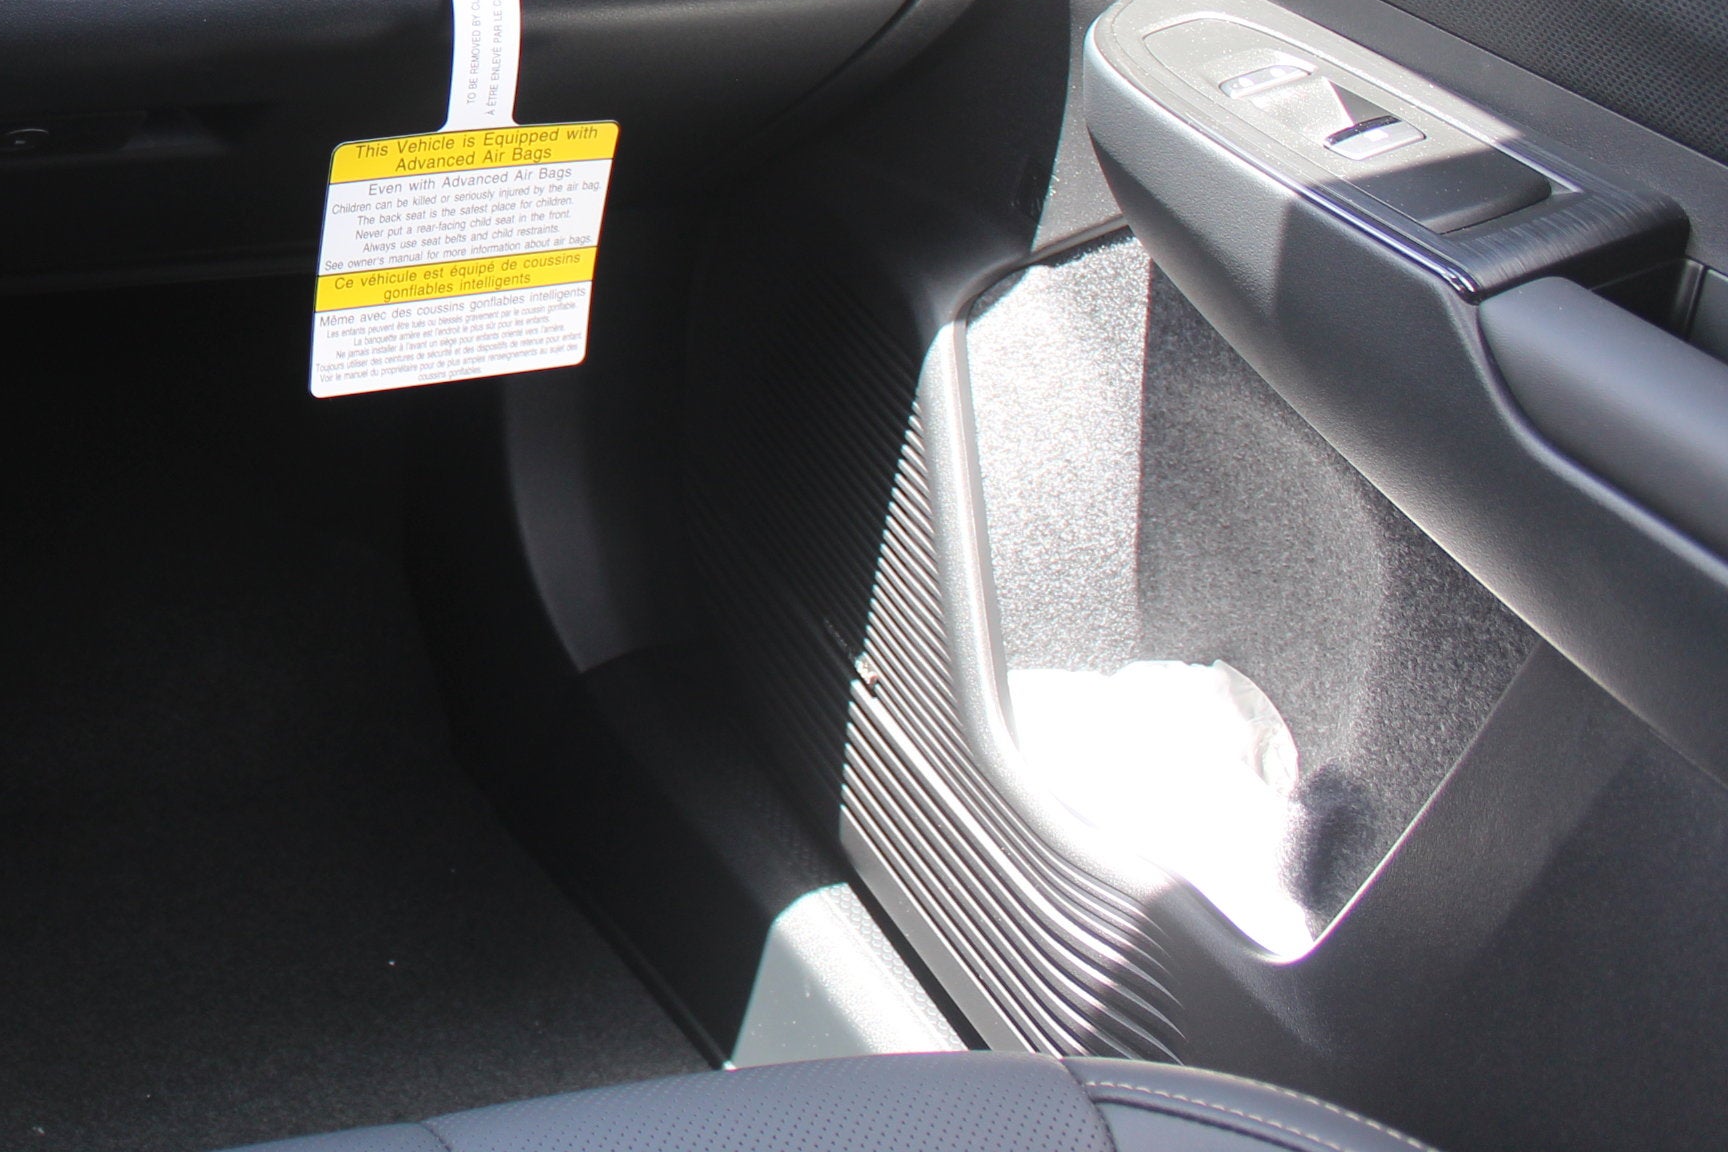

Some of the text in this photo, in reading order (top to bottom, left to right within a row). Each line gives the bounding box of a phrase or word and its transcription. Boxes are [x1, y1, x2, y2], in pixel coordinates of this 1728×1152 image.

[468, 77, 478, 90] BE
[466, 92, 477, 105] TO
[356, 126, 598, 159] This Vehicle is Equipped with
[395, 147, 552, 172] Advanced Air Bags
[368, 167, 571, 196] Even with Advanced Air Bags
[331, 202, 371, 215] Children
[374, 200, 392, 210] can
[396, 197, 408, 208] be
[412, 193, 437, 206] killed
[440, 194, 450, 203] or
[453, 189, 495, 202] seriously
[498, 185, 530, 199] injured
[532, 184, 544, 195] by
[548, 183, 563, 193] the
[566, 183, 578, 191] air
[356, 214, 375, 225] The
[378, 211, 401, 223] back
[405, 209, 426, 221] seat
[429, 208, 437, 218] is
[441, 207, 456, 217] the
[458, 203, 488, 215] safest
[490, 201, 516, 213] place
[519, 199, 533, 209] for
[355, 229, 384, 240] Never
[386, 225, 402, 238] put
[405, 226, 412, 234] a
[416, 219, 466, 233] rear-facing
[469, 215, 491, 228] child
[494, 214, 515, 225] seat
[518, 213, 526, 222] in
[530, 211, 545, 221] the
[362, 241, 396, 253] Always
[399, 239, 417, 249] use
[420, 235, 441, 247] seat
[444, 233, 466, 244] belts
[470, 230, 488, 241] and
[491, 227, 513, 239] child
[324, 259, 343, 271] See
[347, 256, 384, 268] owner's
[388, 250, 423, 263] manual
[426, 249, 439, 259] for
[442, 247, 466, 258] more
[470, 240, 520, 254] information
[523, 237, 550, 249] about
[553, 237, 565, 246] air
[334, 252, 580, 289] Ce véhicule est équipé de coussins
[383, 272, 530, 303] gonflables intelligents
[319, 287, 585, 326] Même avec des coussins gonflables intelligents
